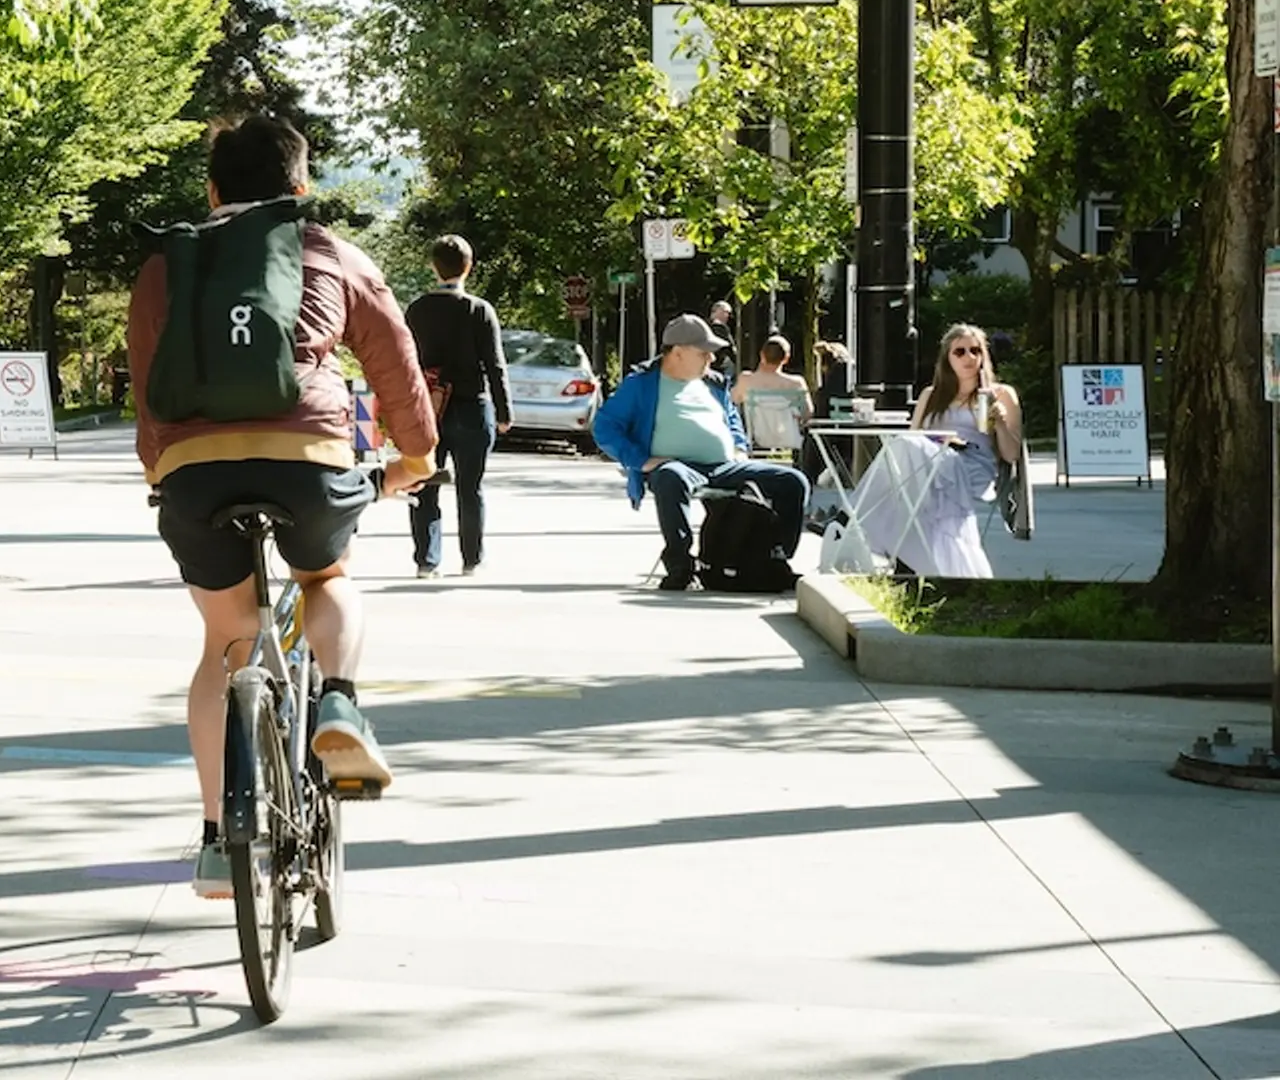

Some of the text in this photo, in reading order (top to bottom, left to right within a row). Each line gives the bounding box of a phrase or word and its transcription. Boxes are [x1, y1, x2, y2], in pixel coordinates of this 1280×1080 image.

[14, 399, 29, 407] NO
[0, 409, 45, 417] SMOKING
[1066, 410, 1143, 419] CHEMICALLY
[1073, 420, 1138, 430] ADDICTED
[1090, 430, 1121, 438] HAIR
